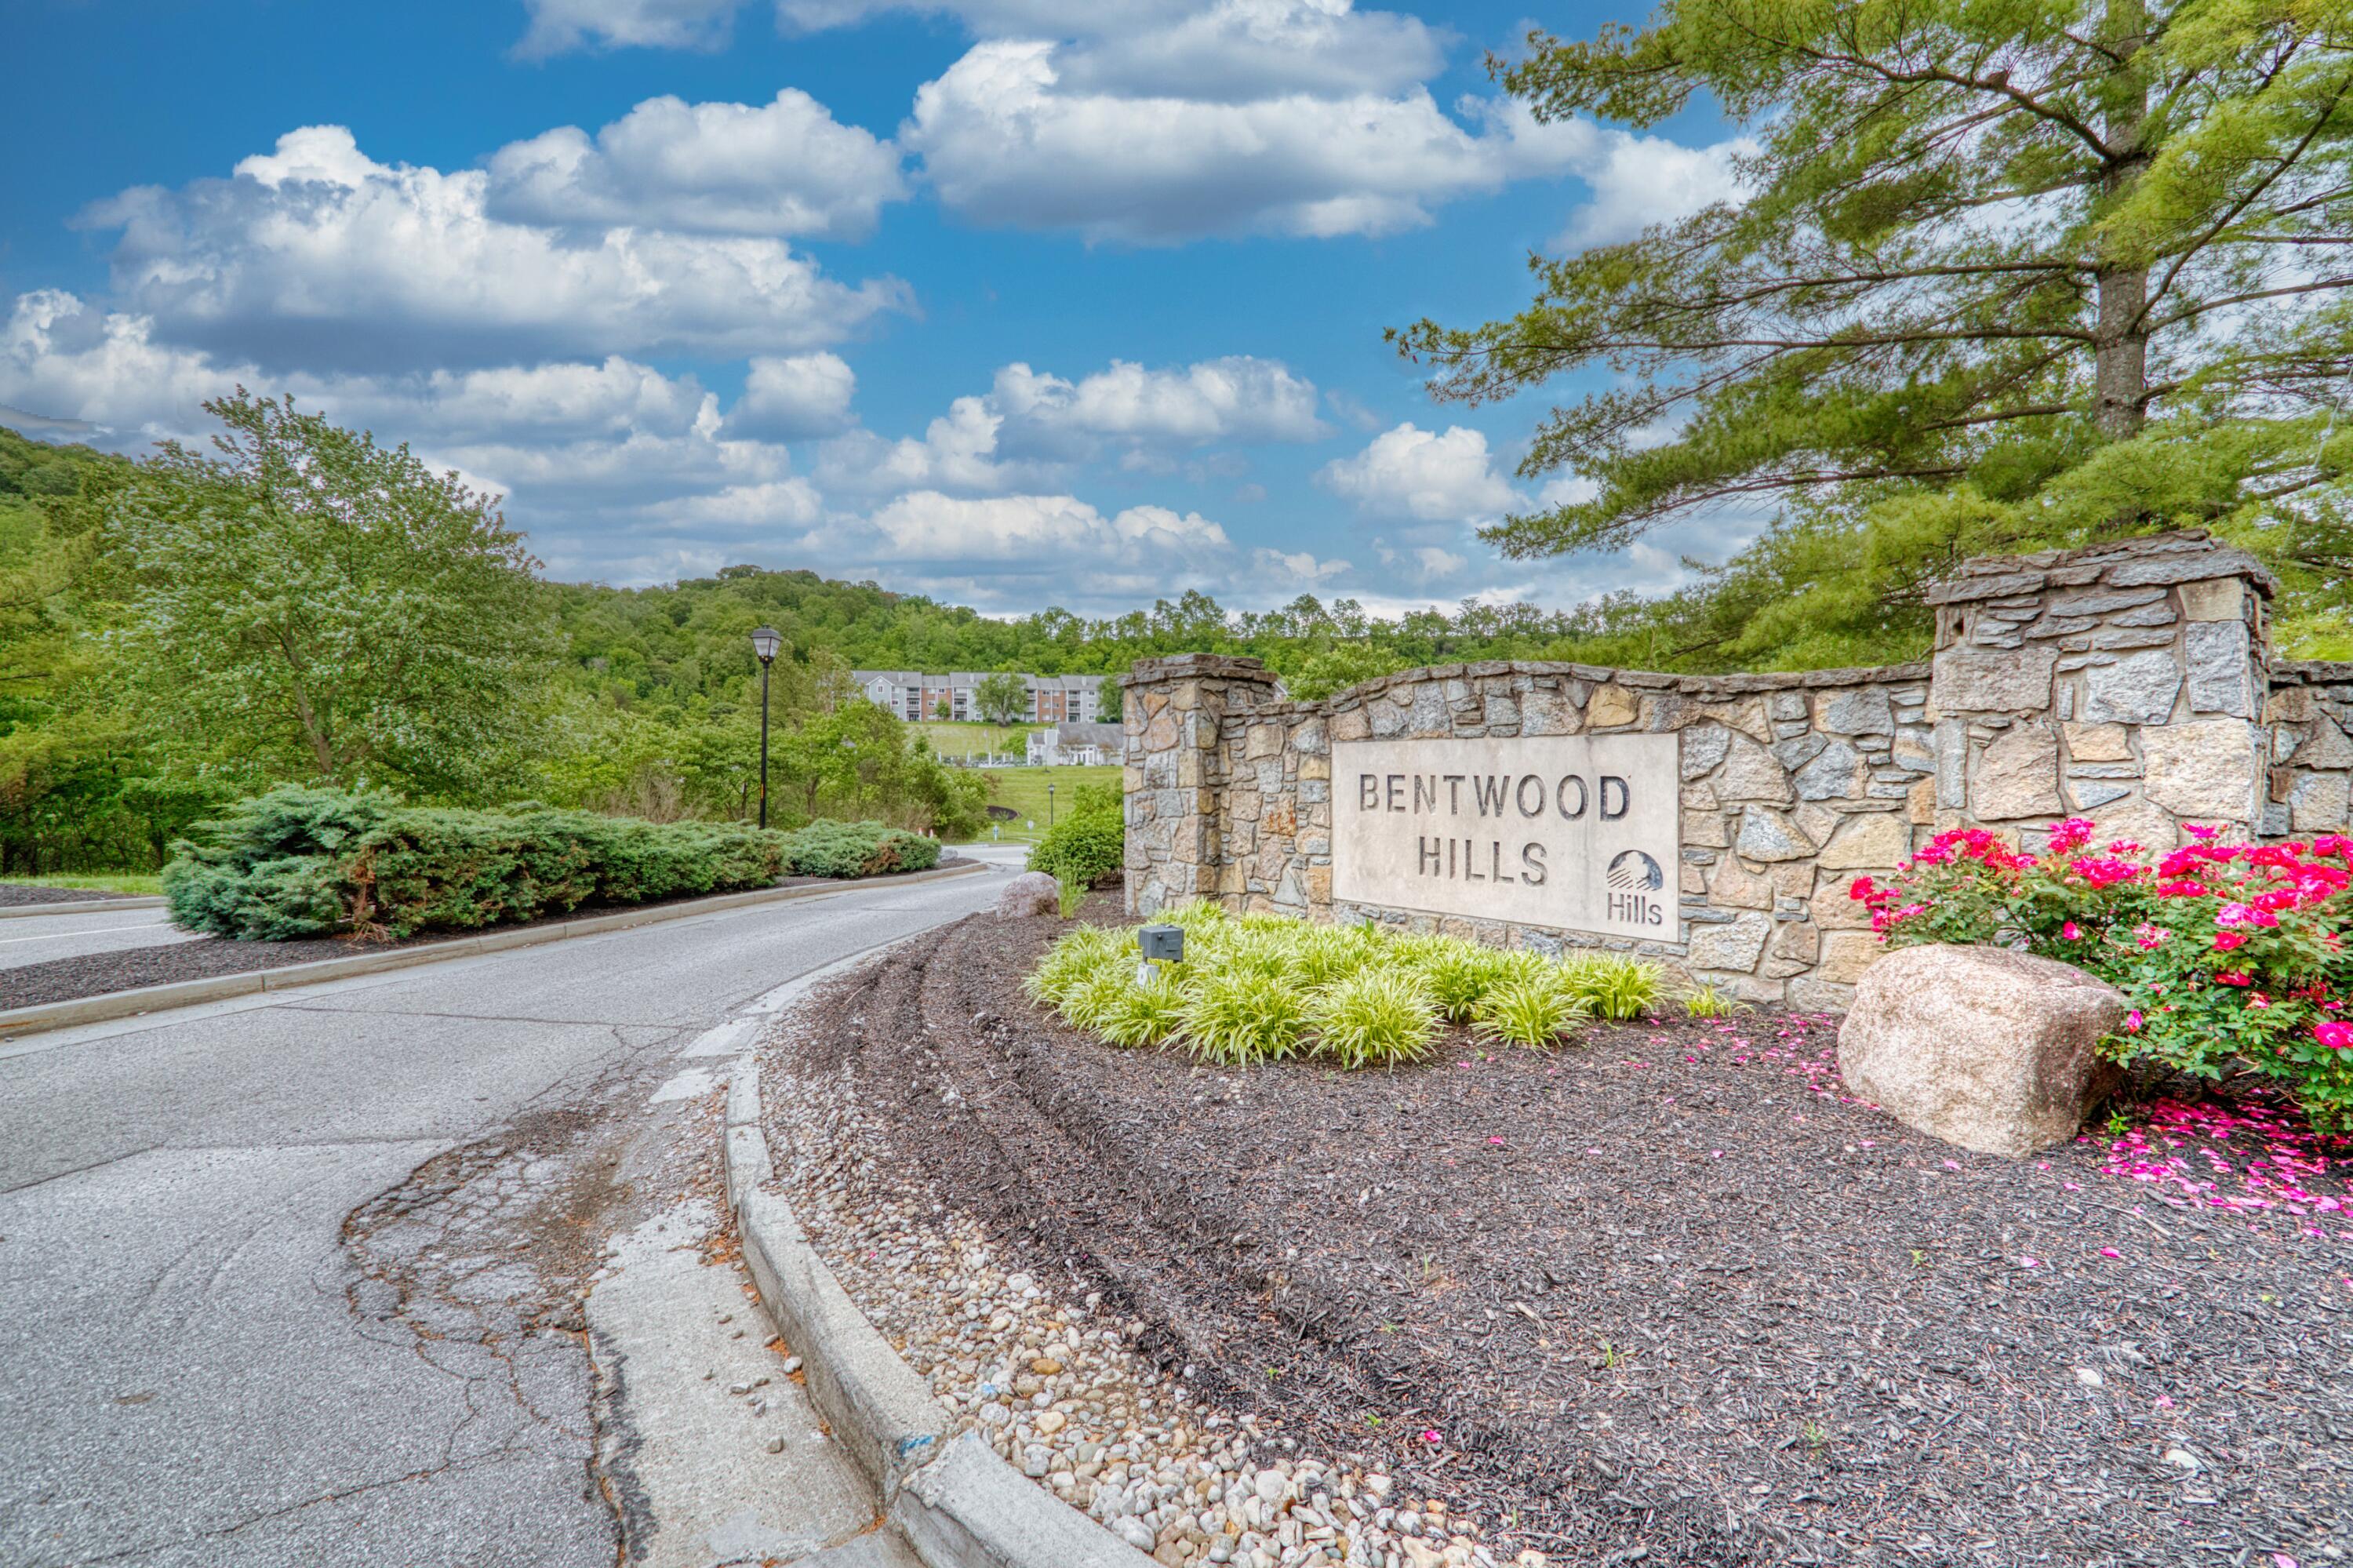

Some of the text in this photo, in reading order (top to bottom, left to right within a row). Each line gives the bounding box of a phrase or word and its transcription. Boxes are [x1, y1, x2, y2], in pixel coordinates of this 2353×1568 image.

[1359, 773, 1631, 821] BENTWOOD
[1419, 836, 1547, 886] HILLS
[1607, 893, 1663, 926] Hills
